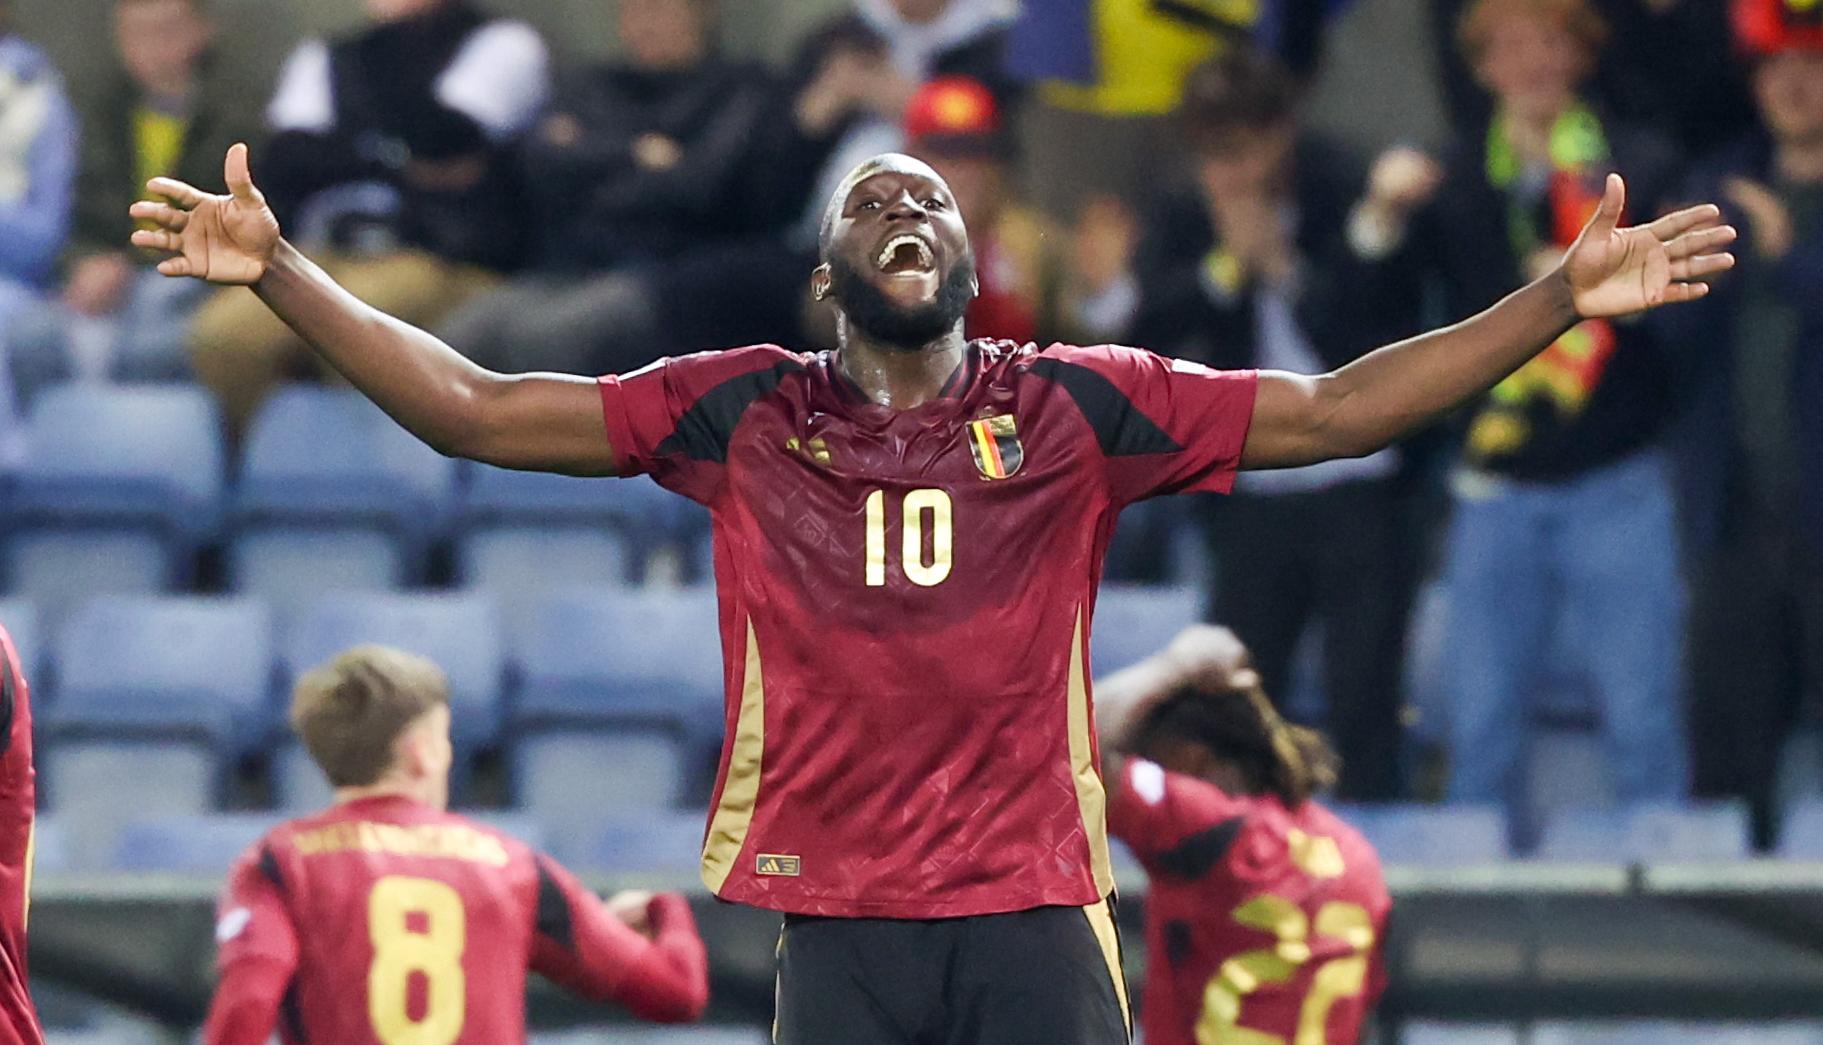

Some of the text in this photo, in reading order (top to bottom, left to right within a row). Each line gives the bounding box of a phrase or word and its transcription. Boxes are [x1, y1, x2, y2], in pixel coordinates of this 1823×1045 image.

[865, 488, 953, 587] 10
[368, 875, 466, 1045] 8
[1194, 894, 1375, 1045] 22
